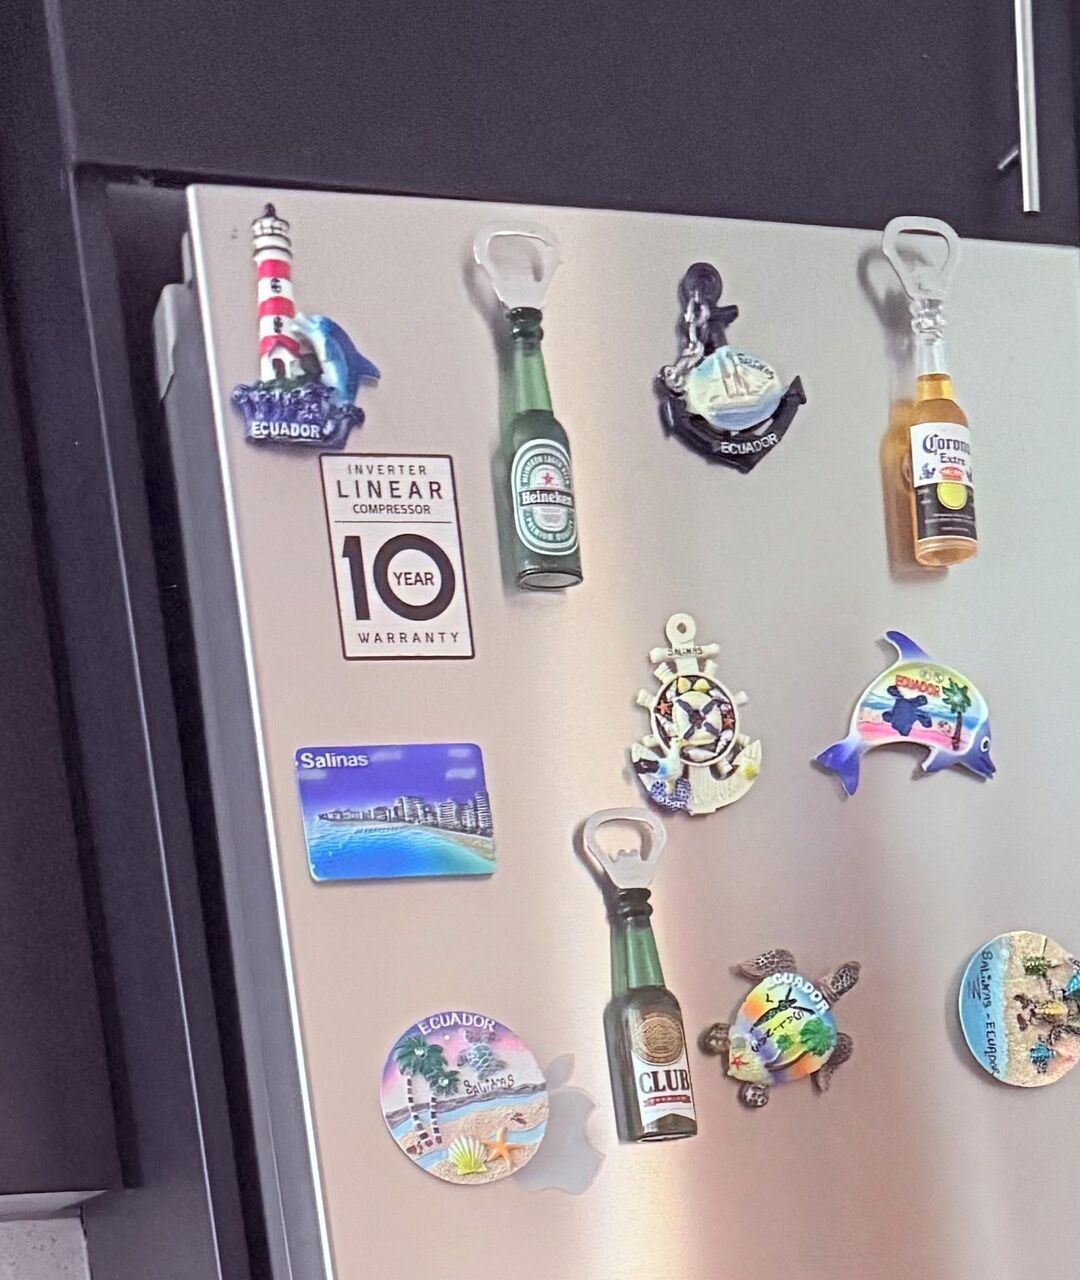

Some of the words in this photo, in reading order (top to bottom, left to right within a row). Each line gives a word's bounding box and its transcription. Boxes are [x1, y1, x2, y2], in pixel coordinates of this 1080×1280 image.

[251, 421, 321, 438] ECUADOR
[720, 433, 778, 454] ECUADOR
[348, 464, 427, 475] INVERTER
[337, 480, 443, 499] LINEAR
[353, 503, 431, 514] COMPRESSOR
[342, 533, 456, 621] 10
[393, 572, 435, 586] YEAR
[358, 632, 459, 643] WARRANTY
[895, 674, 940, 697] ECUADOR
[300, 752, 369, 769] Salinas
[765, 972, 831, 1016] ECUADOR
[417, 1012, 496, 1036] ECUADOR
[639, 1069, 690, 1094] CLUB
